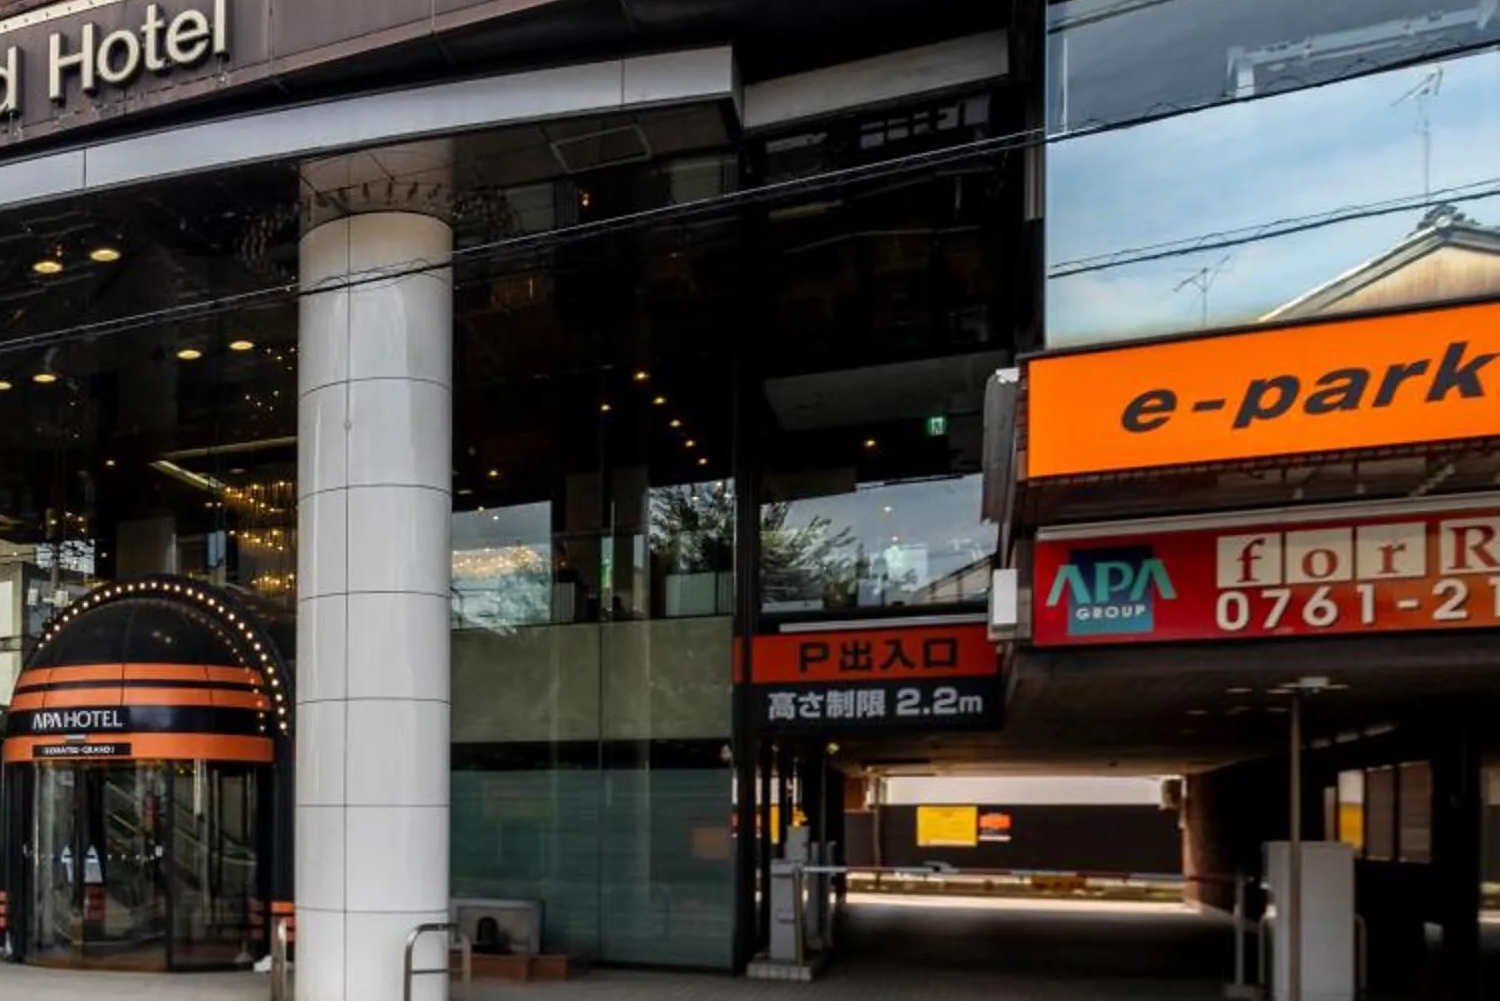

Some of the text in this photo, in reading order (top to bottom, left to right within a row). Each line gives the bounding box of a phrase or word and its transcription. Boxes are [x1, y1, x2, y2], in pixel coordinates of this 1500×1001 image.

[1120, 340, 1500, 433] e-park
[1046, 558, 1177, 607] APA
[1075, 603, 1146, 621] GROUP
[63, 710, 123, 728] HOTEL
[767, 687, 983, 720] 高さ制限 2.2m
